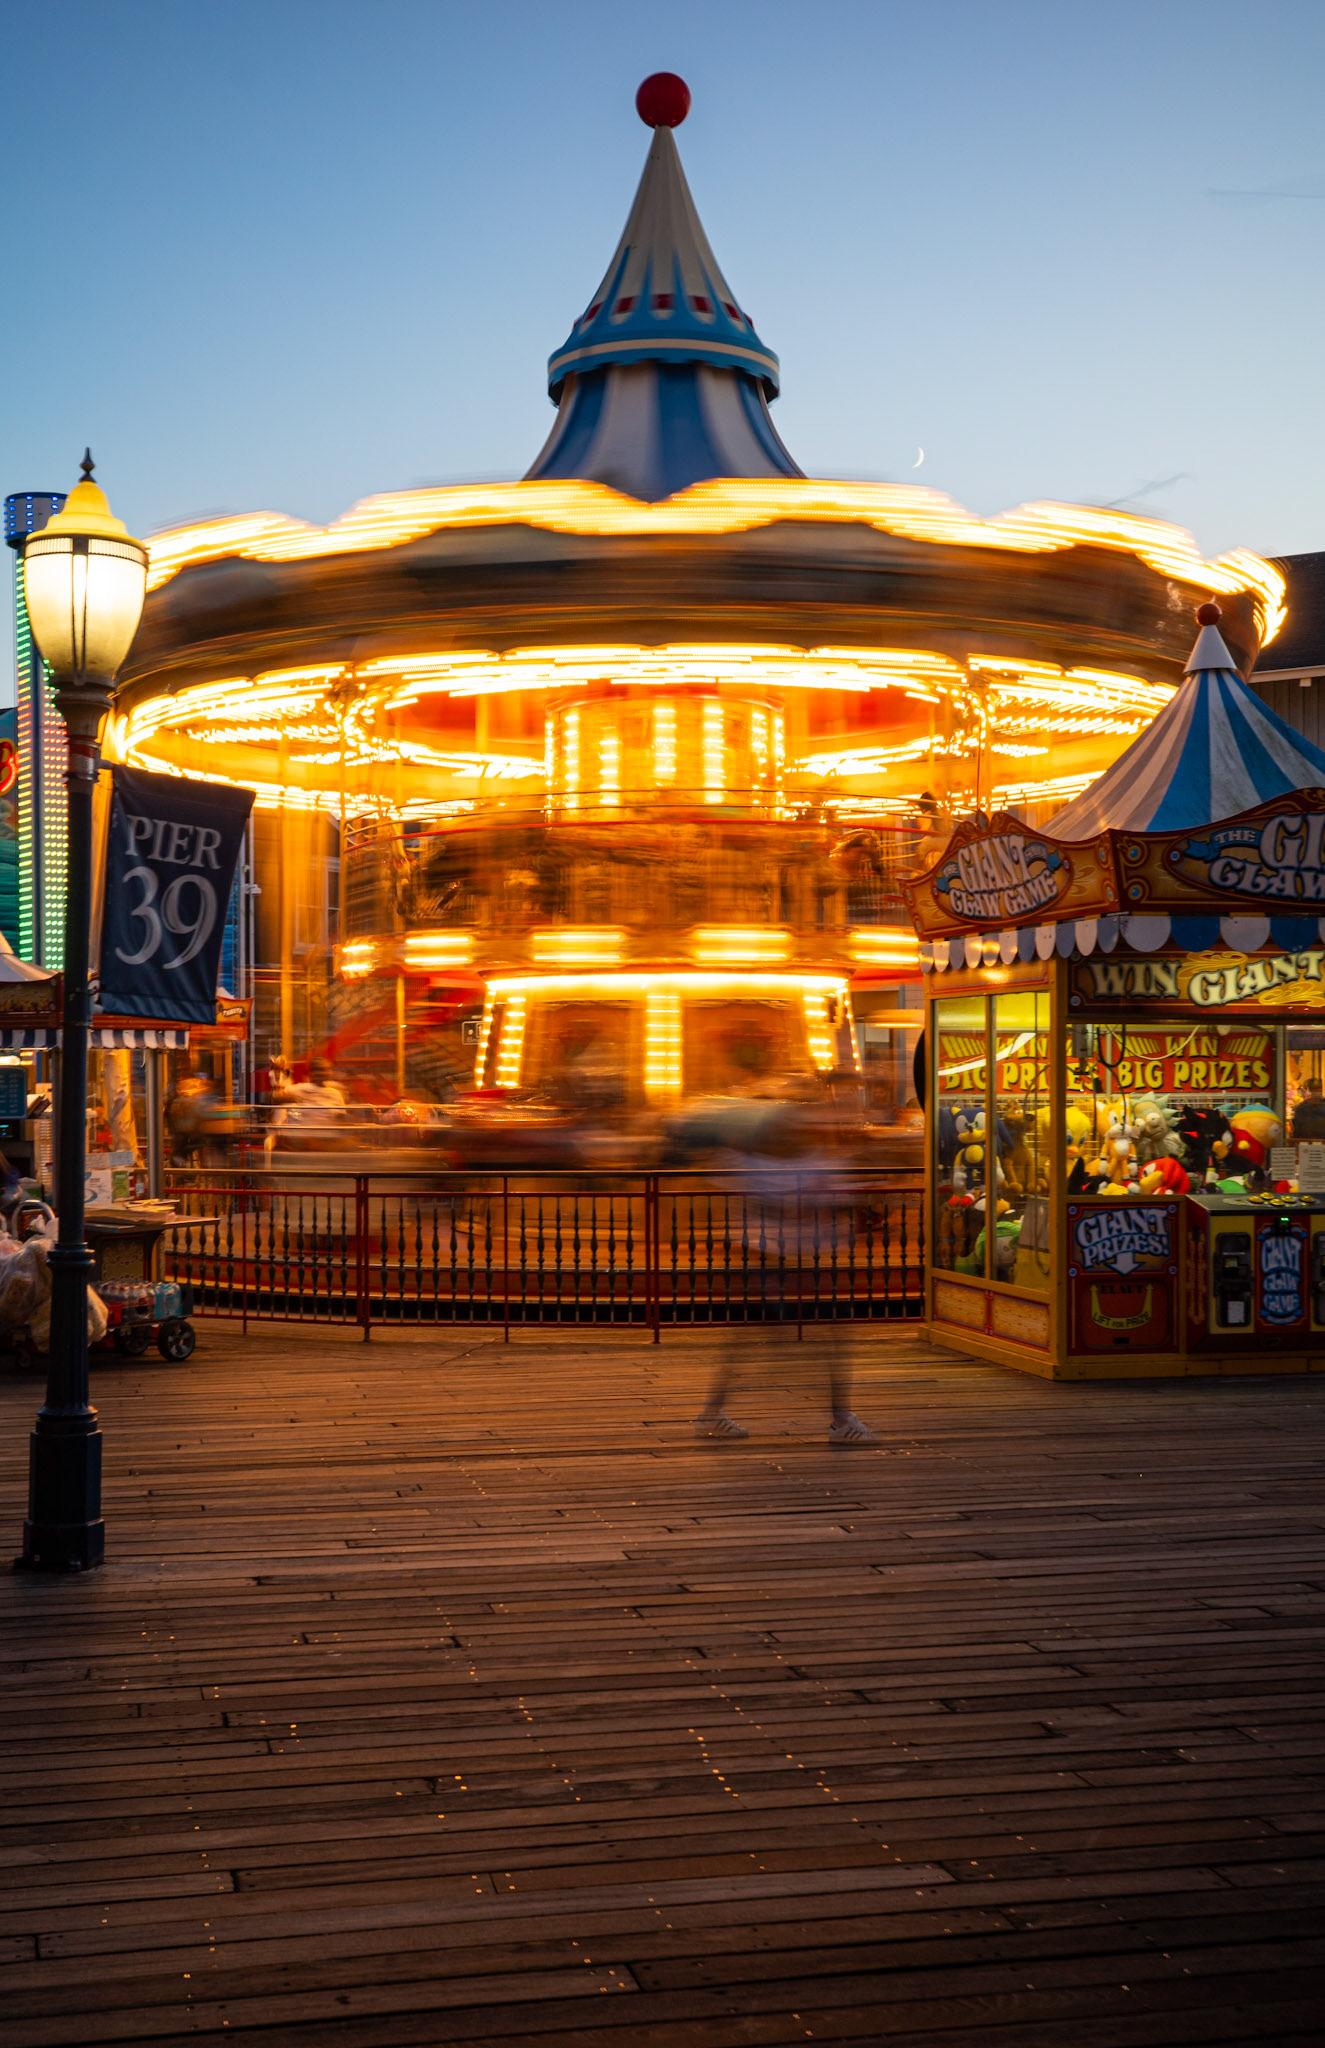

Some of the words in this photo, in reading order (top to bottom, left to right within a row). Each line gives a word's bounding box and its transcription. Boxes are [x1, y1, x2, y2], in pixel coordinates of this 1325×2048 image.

[125, 814, 223, 869] PIER
[1215, 830, 1256, 844] THE
[957, 834, 1032, 893] GIANT
[950, 887, 1001, 917] CLAW
[1003, 868, 1058, 915] GAME
[114, 865, 219, 969] 39
[1089, 961, 1181, 998] WIN
[1188, 950, 1325, 1006] GIANT
[1165, 1036, 1219, 1058] WIN
[1002, 1062, 1099, 1091] PRIES
[1117, 1060, 1164, 1089] BIG
[1174, 1060, 1270, 1090] PRIZES
[1076, 1207, 1169, 1249] GIANT
[1082, 1234, 1170, 1270] PRIZES!
[1093, 1311, 1112, 1326] LIFT
[1126, 1311, 1150, 1327] PRIZE
